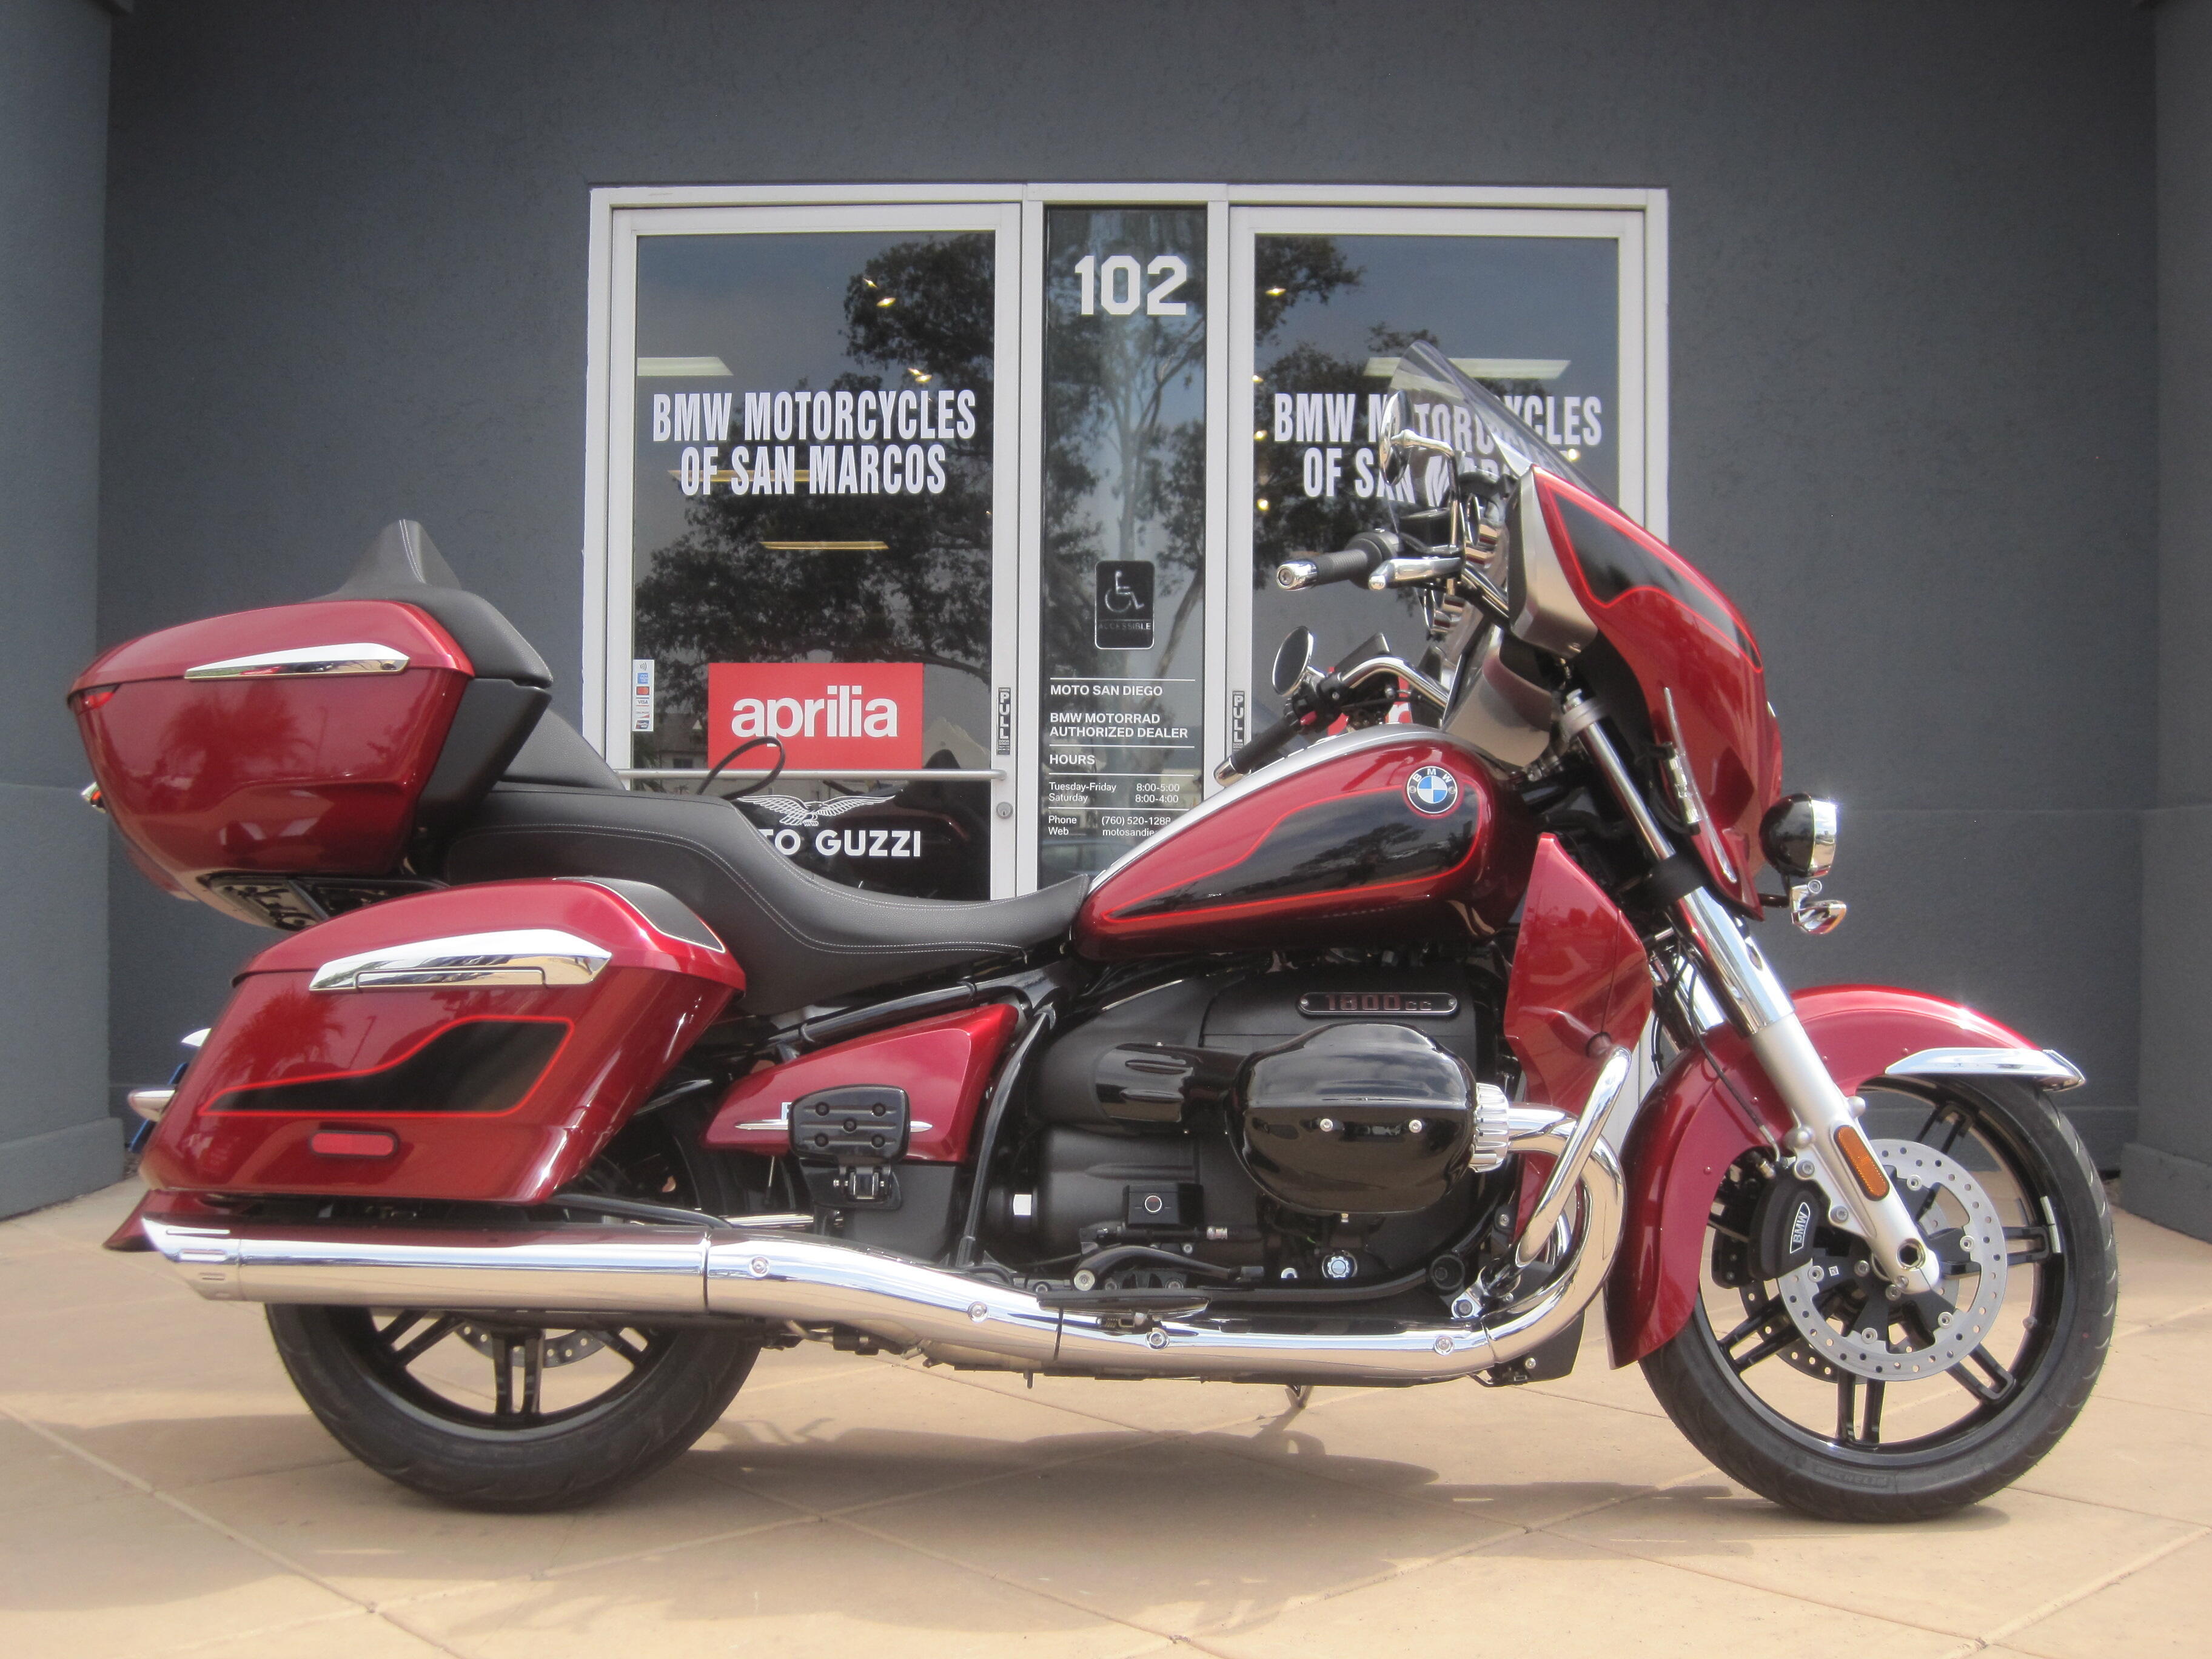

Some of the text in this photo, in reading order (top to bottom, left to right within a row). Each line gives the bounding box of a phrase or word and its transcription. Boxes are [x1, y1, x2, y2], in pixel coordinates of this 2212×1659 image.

[1074, 255, 1187, 315] 102
[653, 389, 976, 442] BMW MOTORCYCLES
[1275, 393, 1355, 442] BMW
[681, 444, 945, 495] OF SAN MARCOS
[1304, 447, 1342, 498] OF
[1050, 685, 1163, 697] MOTO SAN DIEGO
[731, 685, 897, 746] aprilia
[999, 692, 1010, 739] PULL
[1050, 712, 1161, 725] BMW MOTORRAD
[1233, 695, 1244, 742] PULL
[1049, 726, 1188, 739] AUTHORIZED DEALER
[1050, 754, 1096, 765] HOURS
[1048, 782, 1180, 793] Tuesday-Friday 8:00-5:00
[1412, 768, 1452, 783] BMW
[1048, 793, 1179, 804] Saturday 8:00-4:00
[1048, 815, 1171, 826] Phone (760) 520-1288
[1048, 826, 1069, 836] Web
[815, 828, 920, 857] GUZZI
[1792, 1211, 1809, 1243] BMW
